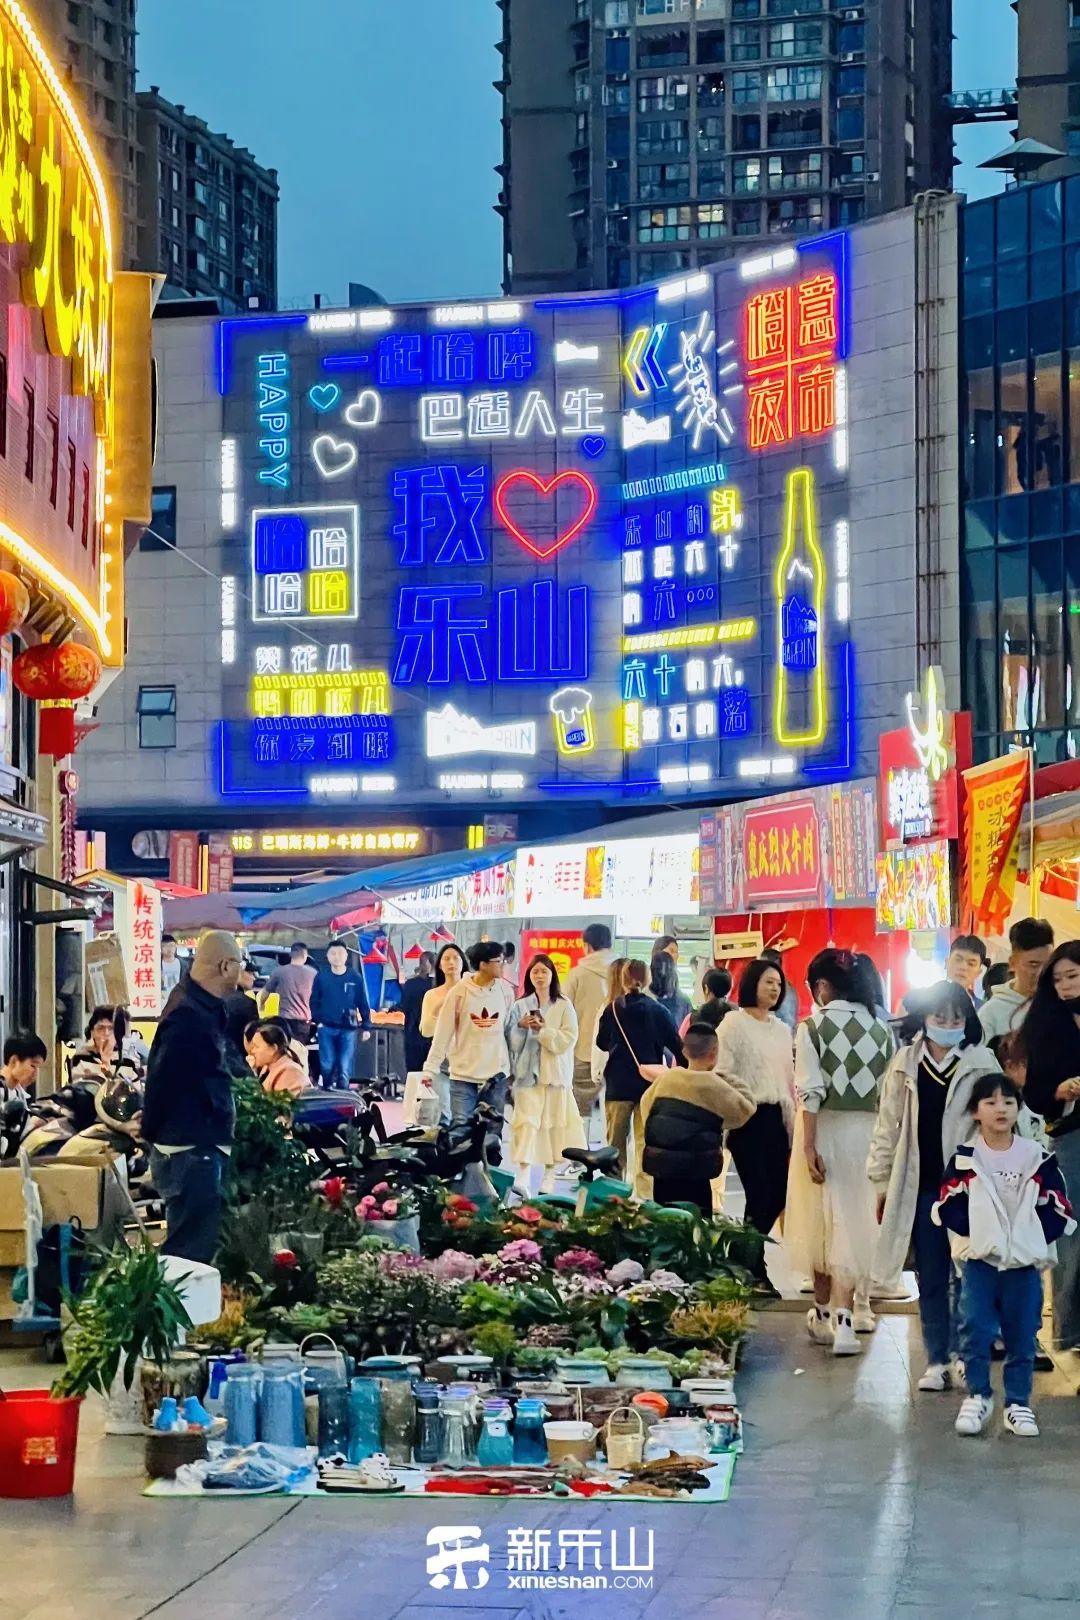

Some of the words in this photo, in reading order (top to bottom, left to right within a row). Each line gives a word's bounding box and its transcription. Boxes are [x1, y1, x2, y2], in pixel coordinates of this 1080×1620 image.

[323, 328, 532, 384] 一起哈啤
[748, 275, 836, 361] 橙意
[258, 353, 288, 488] HAPPY
[421, 387, 605, 440] 巴适人生
[749, 363, 835, 447] 夜市
[394, 465, 485, 564] 我
[393, 580, 588, 683] 乐山
[133, 894, 156, 987] 传统凉糕
[133, 995, 157, 1009] 4元
